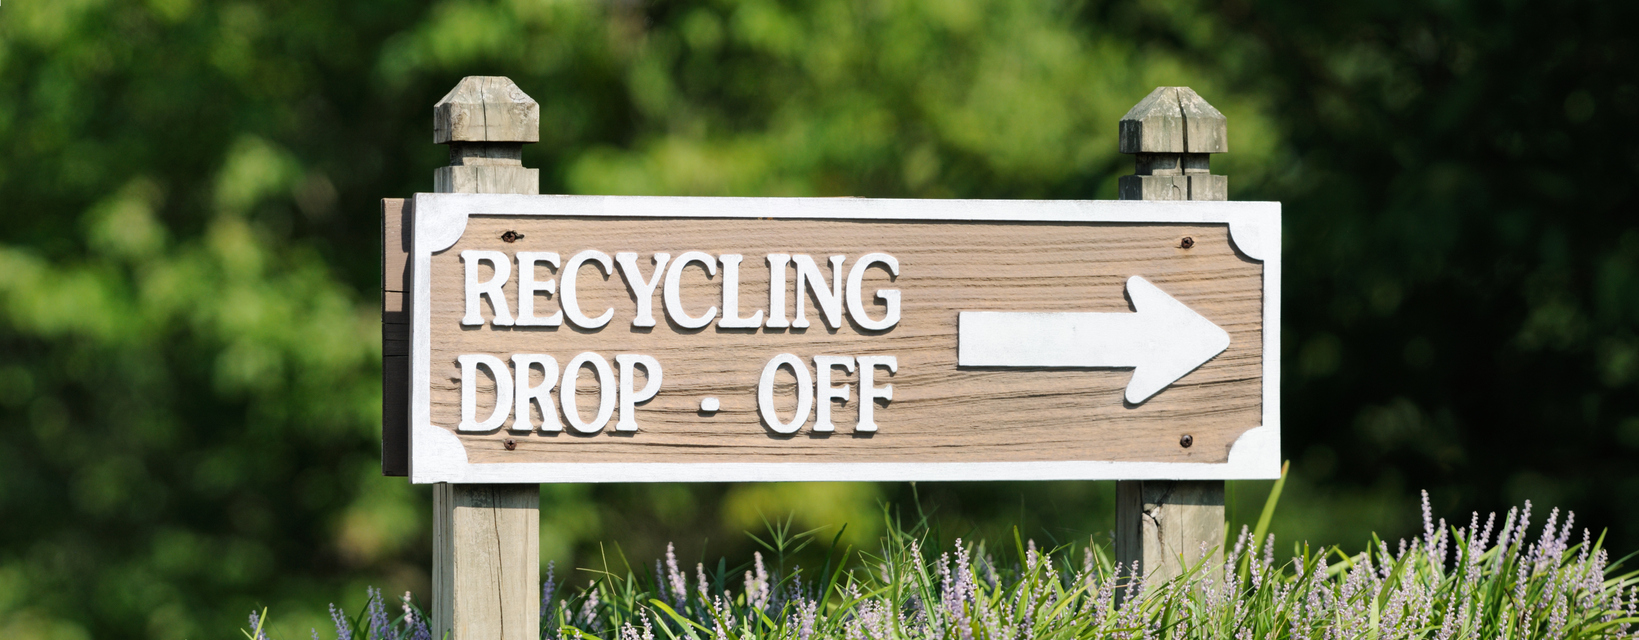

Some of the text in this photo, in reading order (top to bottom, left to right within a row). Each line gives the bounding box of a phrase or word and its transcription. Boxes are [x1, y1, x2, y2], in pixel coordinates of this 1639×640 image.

[459, 249, 902, 330] RECYCLING
[457, 351, 664, 434] DROP
[758, 352, 899, 434] OFF
